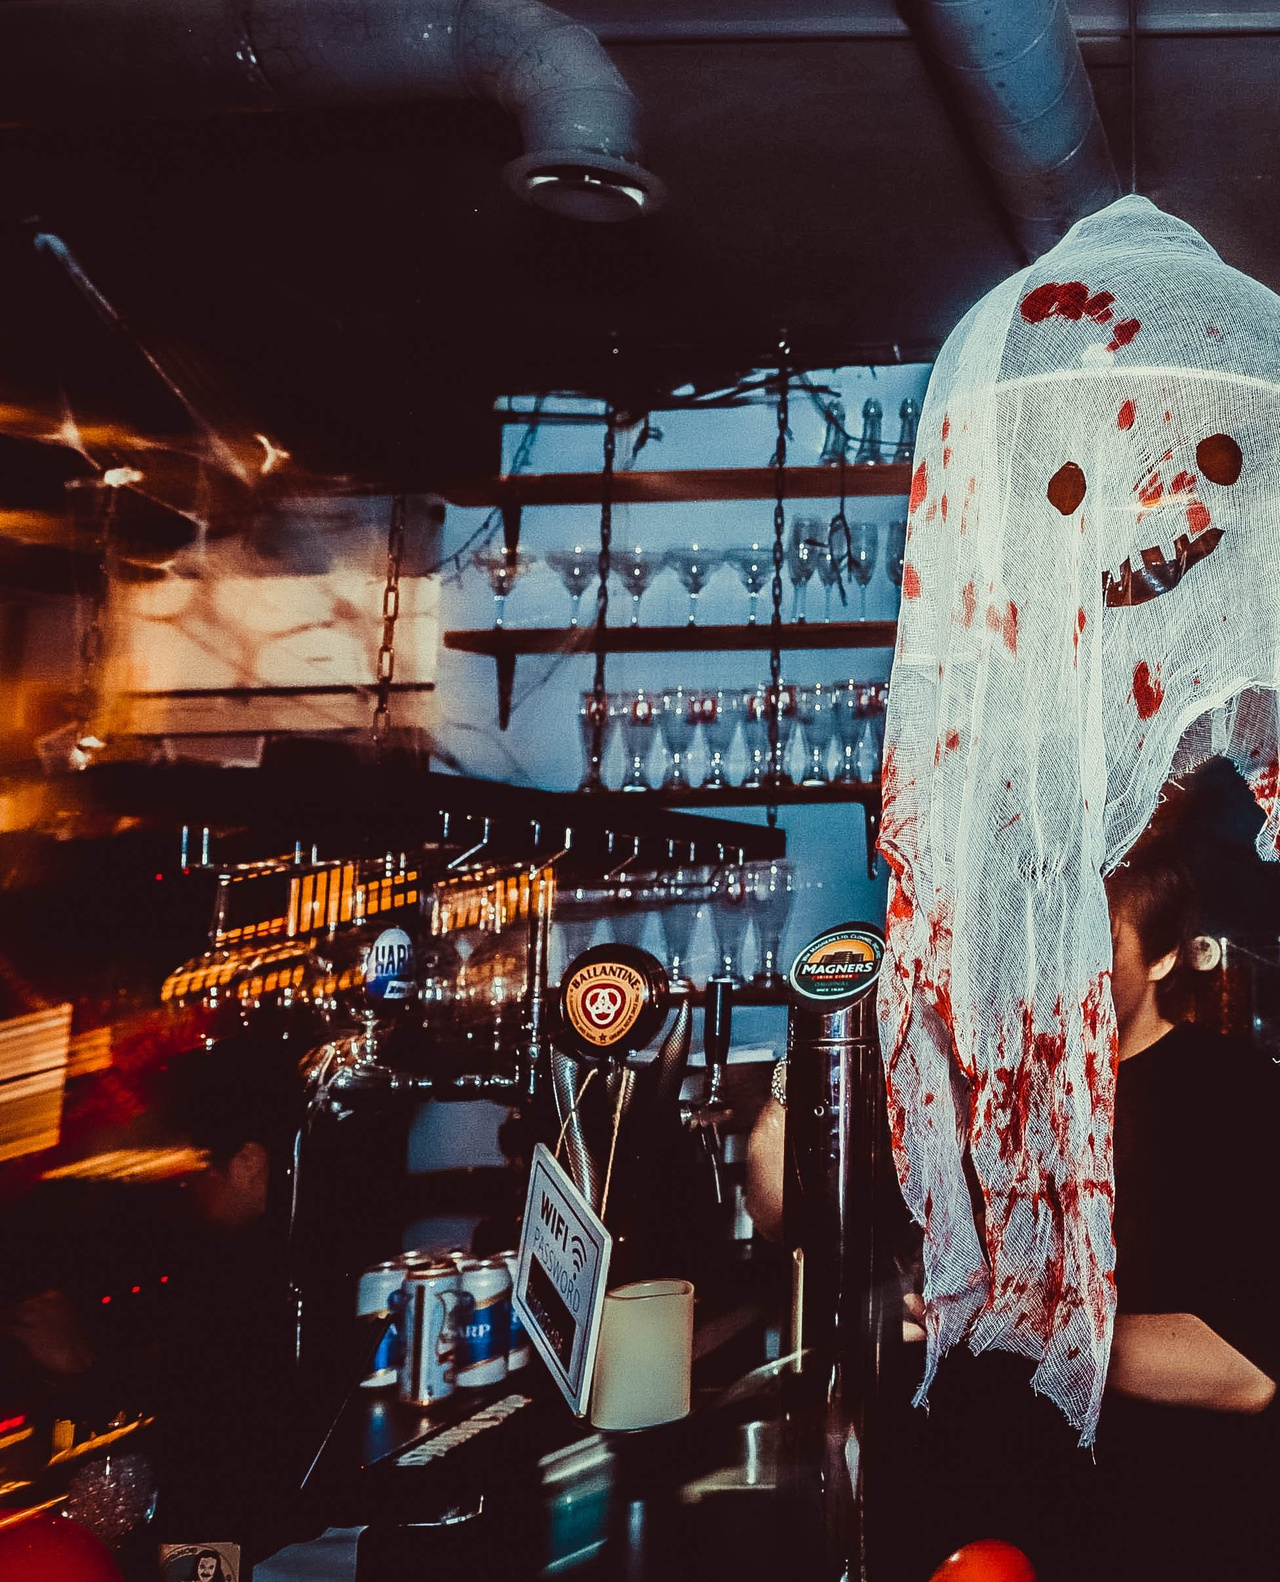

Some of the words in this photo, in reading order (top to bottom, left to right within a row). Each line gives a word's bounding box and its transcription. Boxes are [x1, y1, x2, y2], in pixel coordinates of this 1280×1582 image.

[571, 965, 641, 990] BALLANTINE
[801, 962, 874, 975] MAGNERS
[540, 1190, 569, 1252] WIFI
[533, 1226, 581, 1312] PASSWORD
